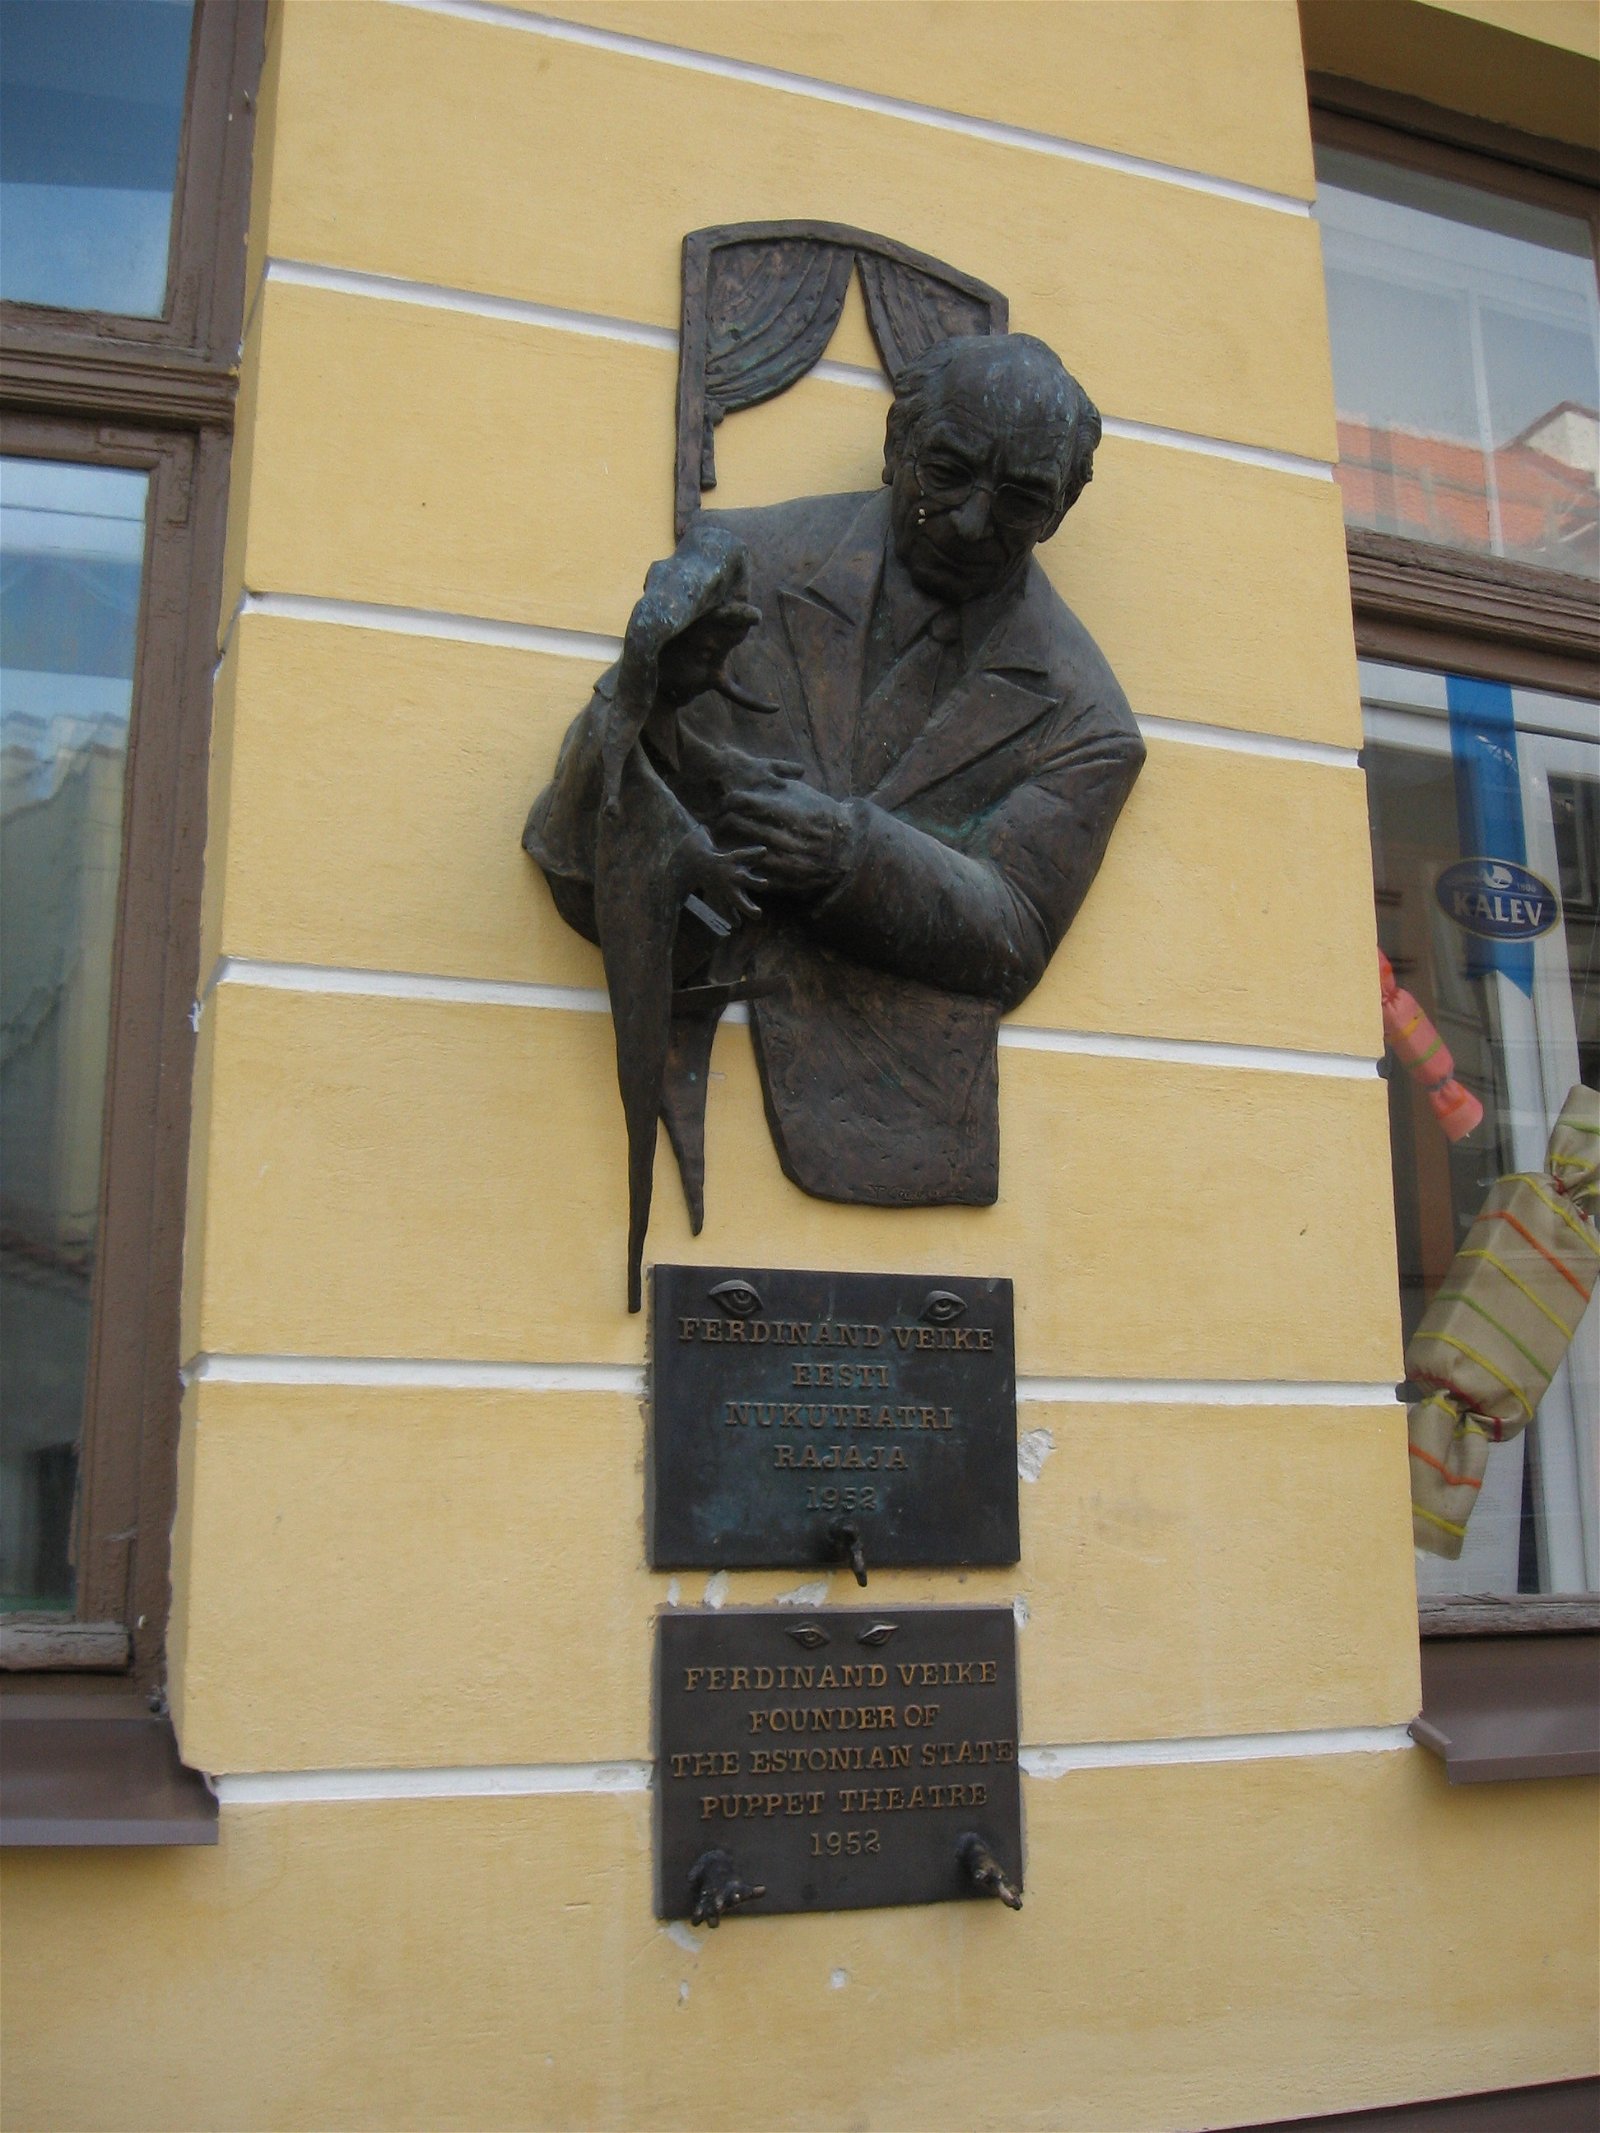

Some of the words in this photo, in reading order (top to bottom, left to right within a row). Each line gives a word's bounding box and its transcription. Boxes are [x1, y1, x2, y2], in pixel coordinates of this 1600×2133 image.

[1452, 890, 1543, 928] KALEV
[678, 1317, 884, 1347] FERDINAND
[891, 1326, 995, 1352] VEIKE
[791, 1362, 889, 1387] EESTI
[725, 1402, 953, 1429] NUKUTEATRI
[774, 1445, 908, 1471] RAJAJA
[806, 1486, 878, 1511] 1952
[684, 1663, 889, 1691] FERDINAND
[896, 1661, 998, 1686] VEIKE
[748, 1708, 898, 1734] FOUNDER
[903, 1704, 941, 1727] OF
[670, 1752, 740, 1777] THE
[749, 1745, 914, 1775] ESTONIAN
[921, 1740, 1015, 1767] STATE
[700, 1791, 826, 1819] PUPPET
[837, 1784, 988, 1813] THEATRE
[810, 1830, 881, 1857] 1952
